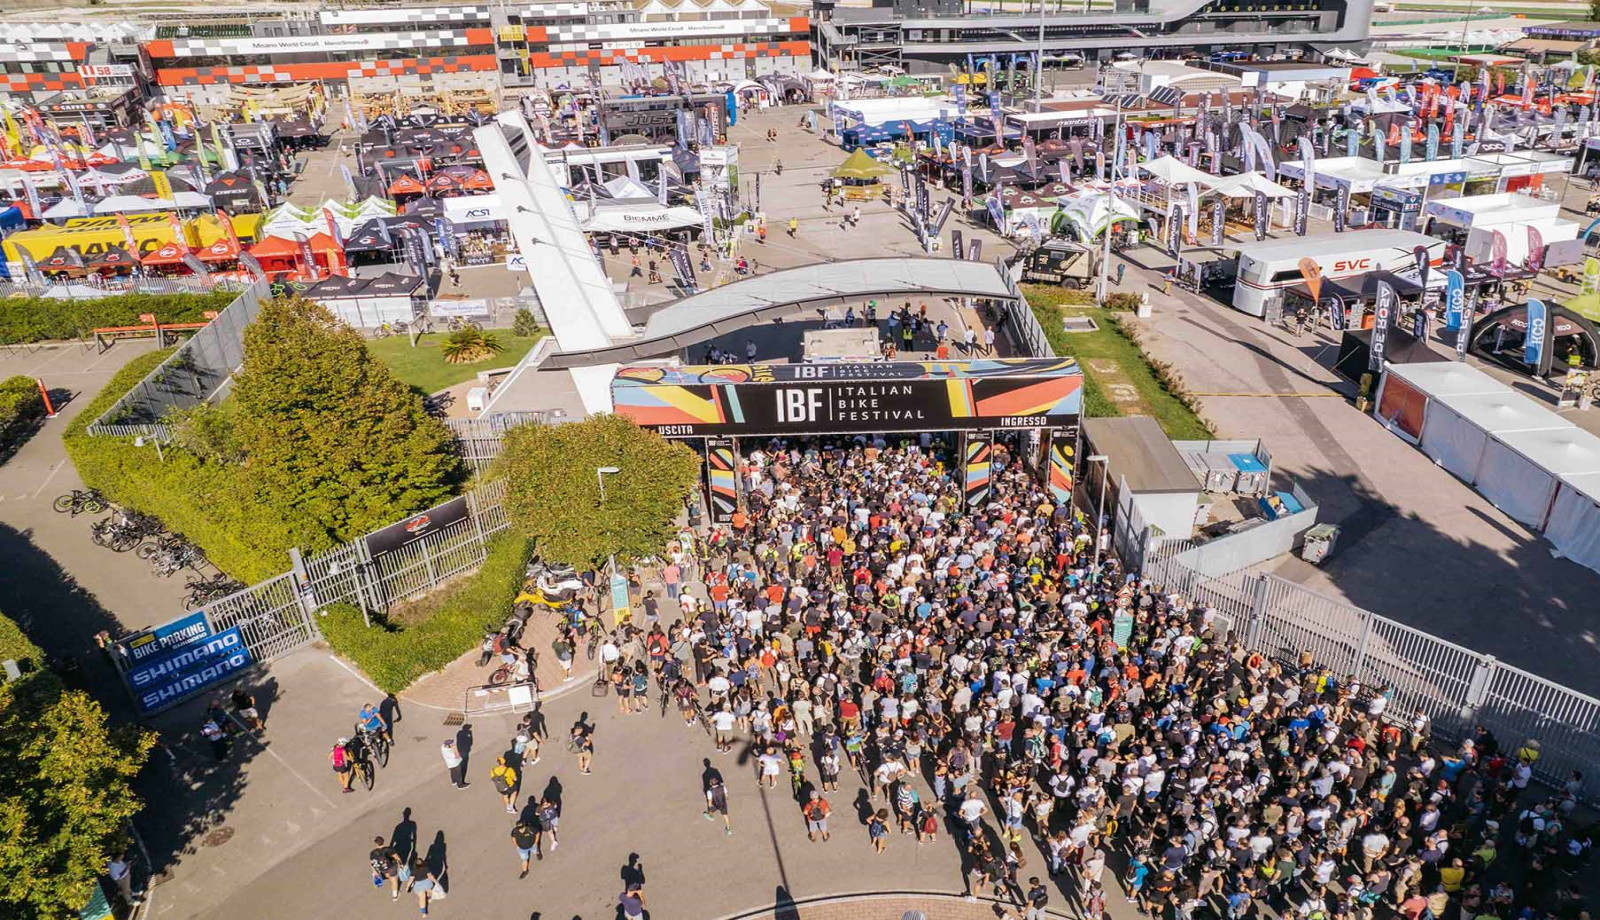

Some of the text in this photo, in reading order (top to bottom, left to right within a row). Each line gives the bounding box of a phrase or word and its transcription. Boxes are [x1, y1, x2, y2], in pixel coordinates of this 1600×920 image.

[1334, 257, 1371, 272] SVC
[794, 366, 829, 378] IBF
[838, 385, 913, 397] ITALIAN
[775, 388, 823, 423] IBF
[838, 398, 879, 409] BIKE
[838, 410, 925, 421] FESTIVAL
[1000, 416, 1047, 426] INGRESSO
[658, 425, 693, 435] USCITA
[133, 621, 205, 659] BIKE PARKING
[132, 633, 239, 686] SHIMANO
[142, 654, 246, 707] SHIMANO
